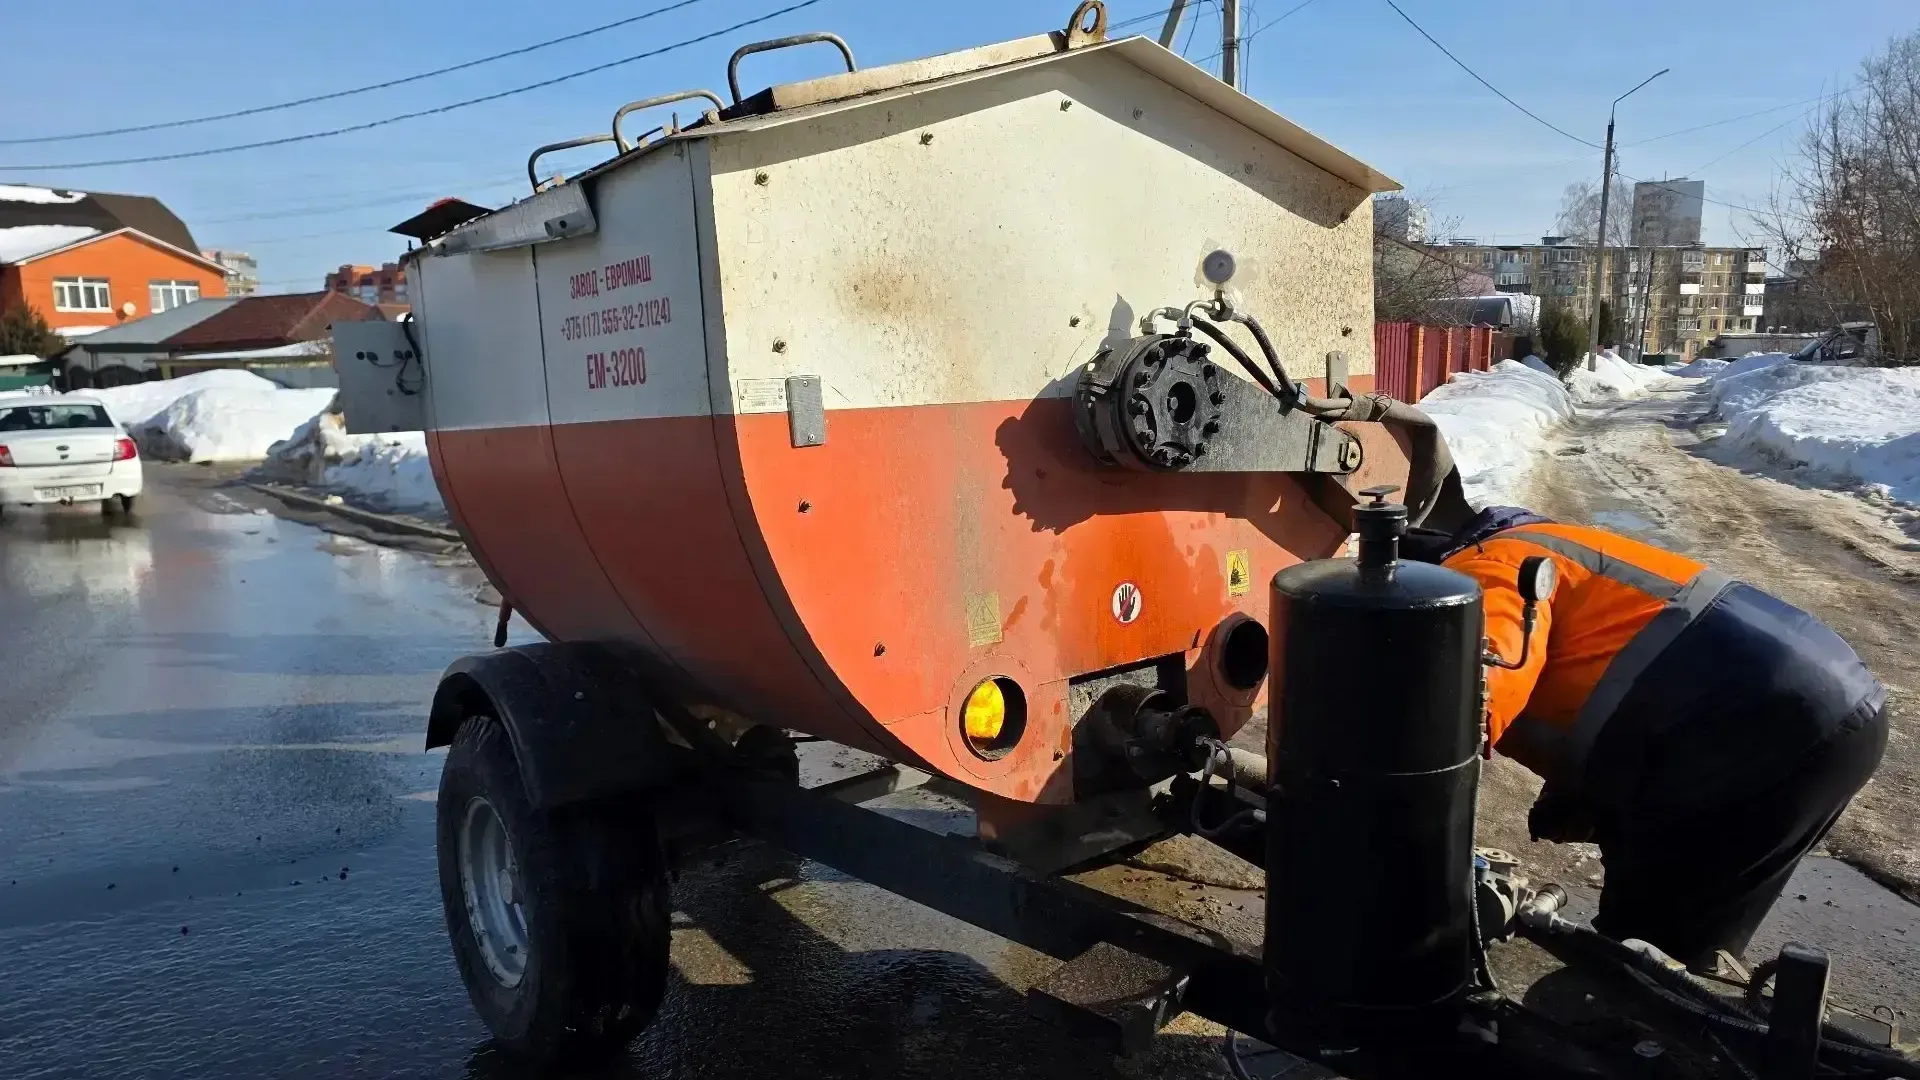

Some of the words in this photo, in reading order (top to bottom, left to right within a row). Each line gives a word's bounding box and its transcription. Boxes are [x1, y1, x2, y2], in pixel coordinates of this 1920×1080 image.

[570, 269, 599, 299] ЗАВОД
[605, 254, 651, 291] ЕВРОМАШ
[561, 316, 581, 340] +375
[583, 311, 600, 337] (17)
[586, 346, 646, 389] ЕМ-3200
